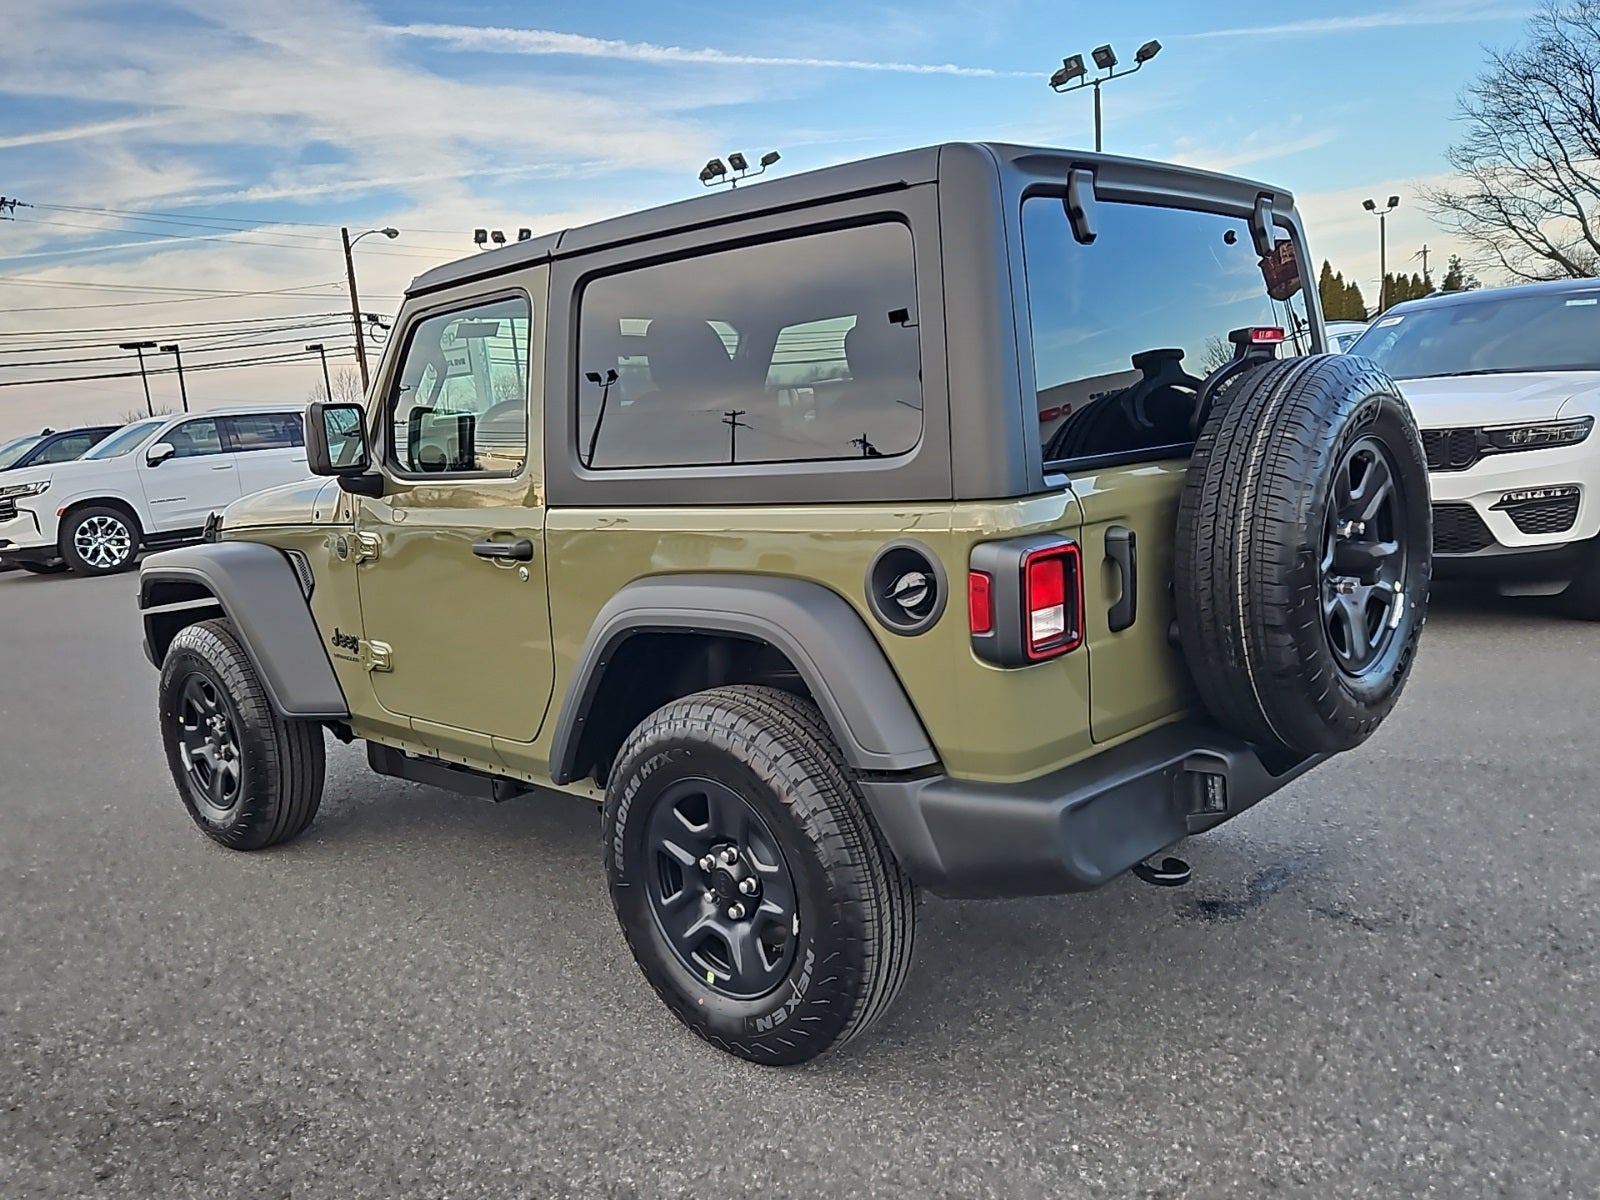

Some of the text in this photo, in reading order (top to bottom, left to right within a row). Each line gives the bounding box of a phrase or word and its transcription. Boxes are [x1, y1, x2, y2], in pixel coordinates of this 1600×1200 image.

[447, 358, 466, 367] AM
[331, 627, 360, 655] Jeep
[613, 773, 642, 872] ROADIAN
[755, 948, 816, 1033] NEXEN
